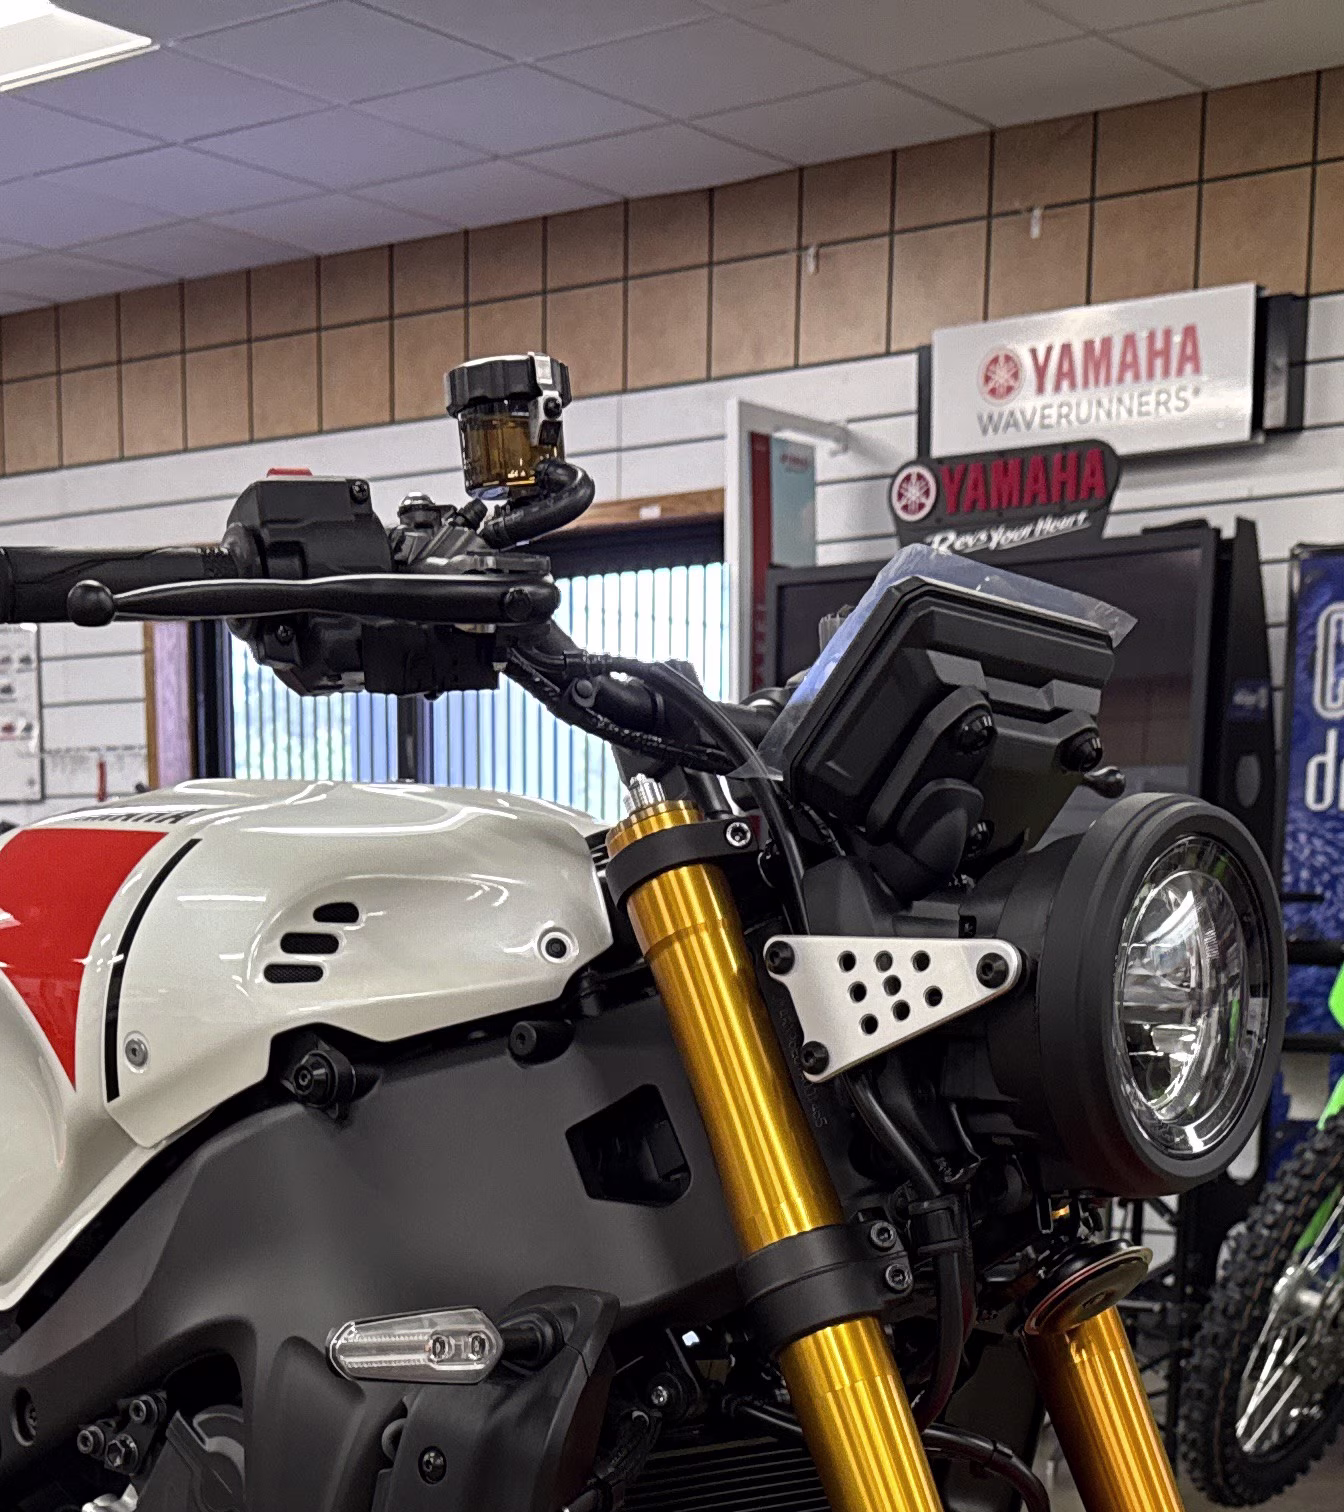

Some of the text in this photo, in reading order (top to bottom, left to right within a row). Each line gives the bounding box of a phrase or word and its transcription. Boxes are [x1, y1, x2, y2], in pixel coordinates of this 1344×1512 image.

[1029, 324, 1202, 396] YAMAHA
[977, 385, 1192, 437] WAVERUNNERS
[940, 448, 1106, 515] YAMAHA
[985, 519, 1036, 550] Your
[1035, 510, 1092, 537] Heart
